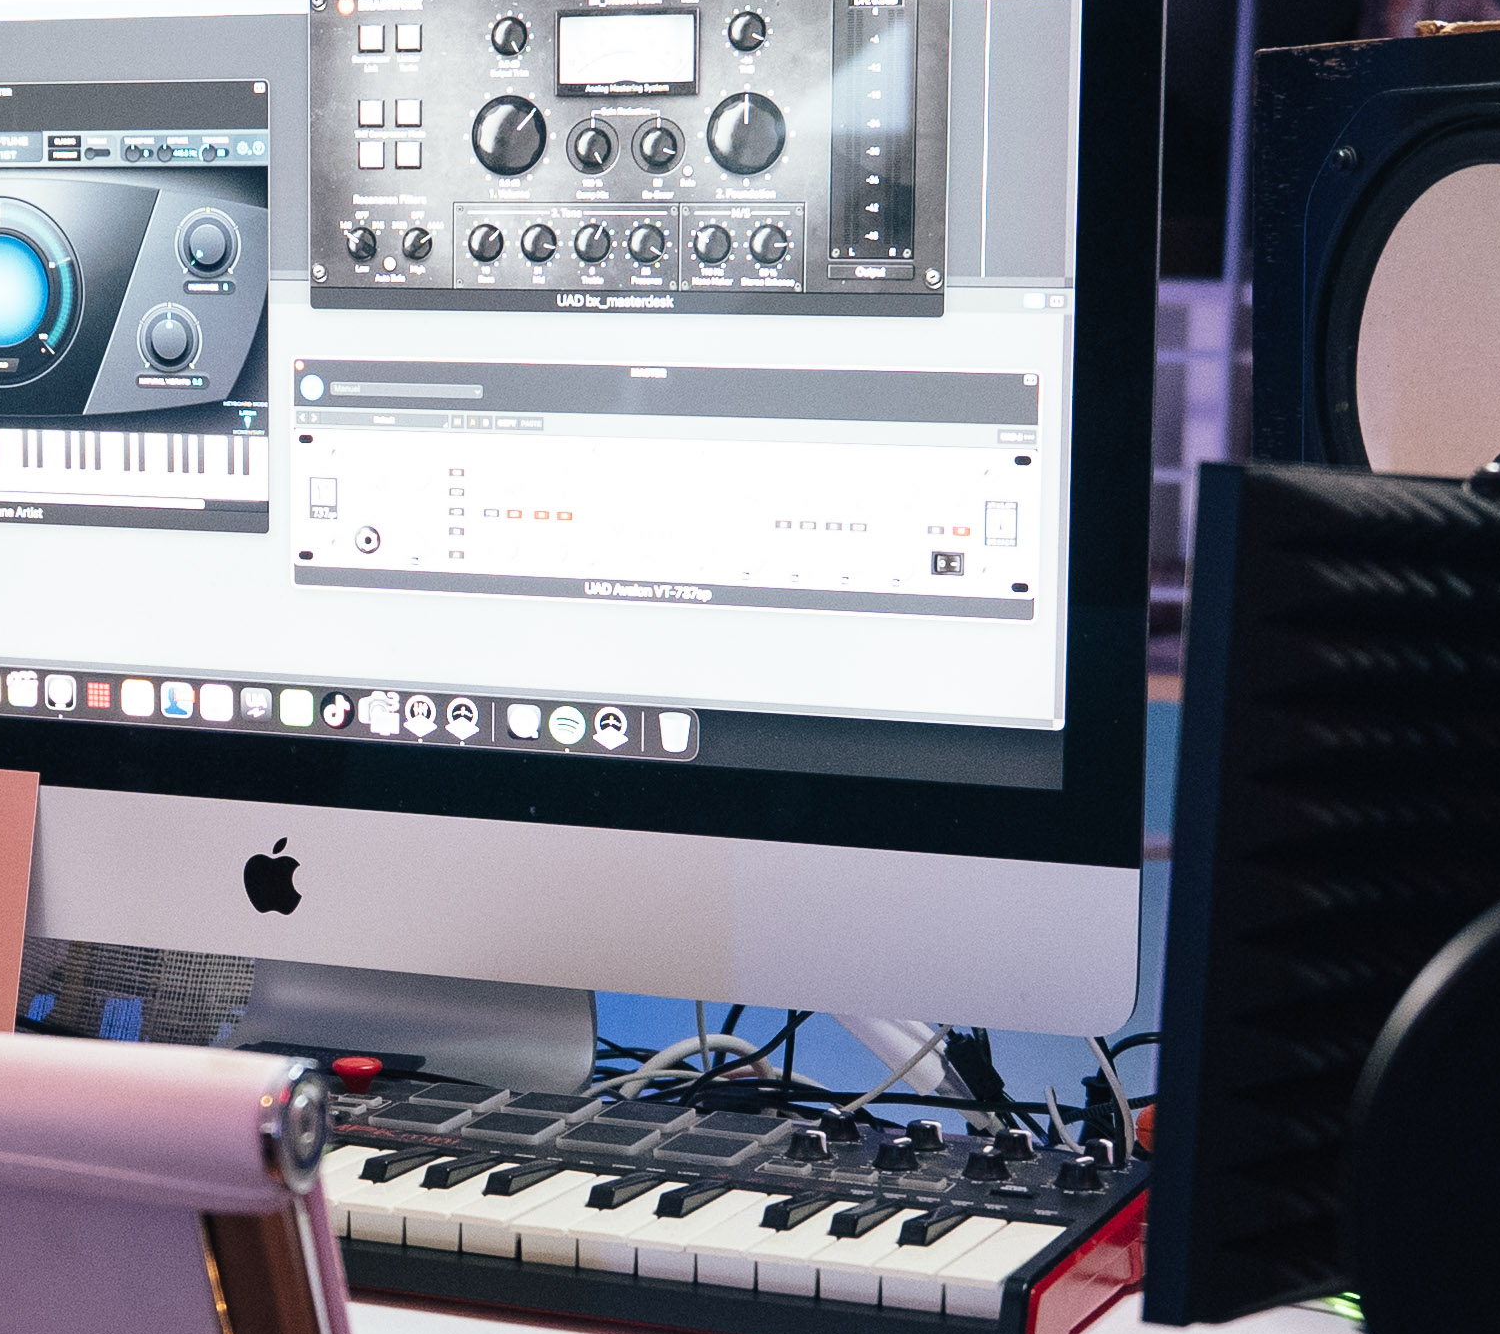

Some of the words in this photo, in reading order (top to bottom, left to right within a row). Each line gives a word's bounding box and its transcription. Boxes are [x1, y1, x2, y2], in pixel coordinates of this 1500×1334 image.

[557, 294, 584, 307] UAD
[585, 294, 675, 310] bx_masterdesk
[14, 506, 43, 520] Artist
[584, 581, 612, 597] UAD
[613, 583, 653, 599] Avalon
